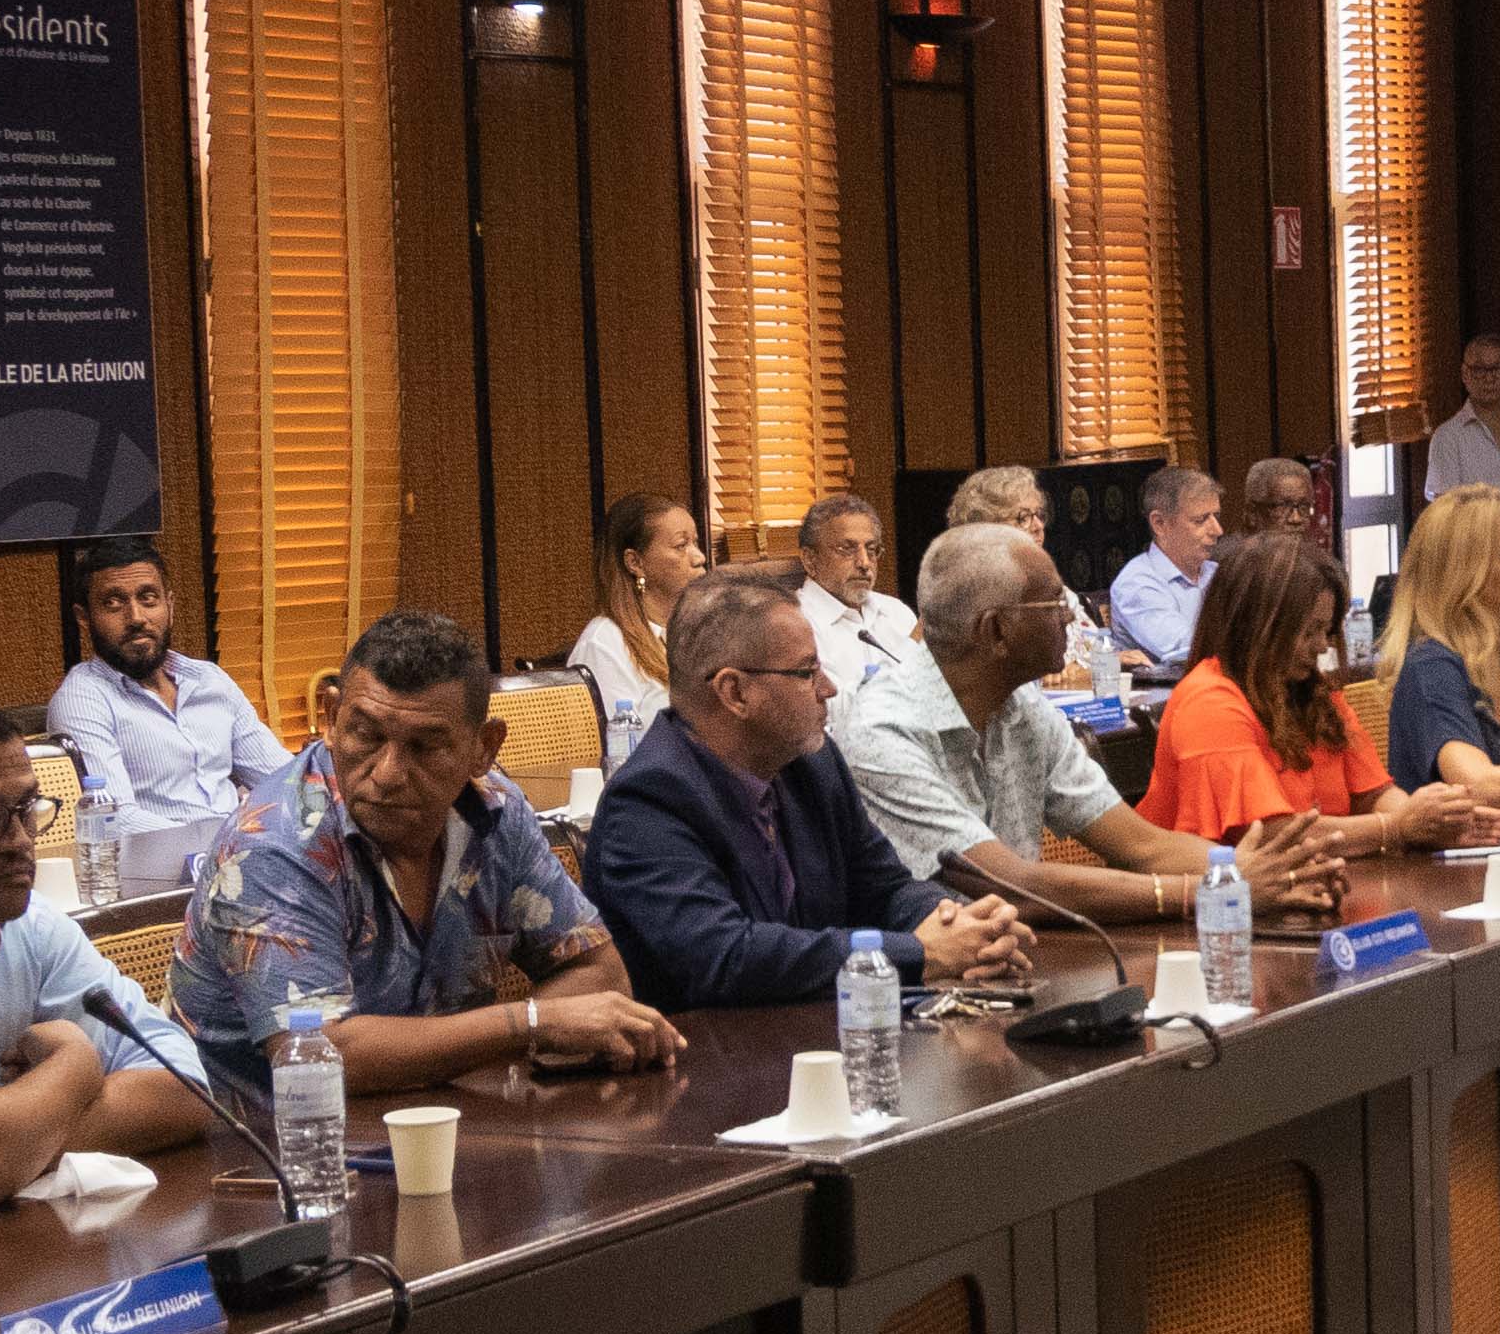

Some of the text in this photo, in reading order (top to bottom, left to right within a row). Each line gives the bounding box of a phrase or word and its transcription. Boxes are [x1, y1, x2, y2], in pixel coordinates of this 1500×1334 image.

[20, 364, 44, 384] DE
[47, 363, 69, 383] LA
[71, 358, 145, 382] RÉUNION
[134, 1291, 202, 1322] REUNION
